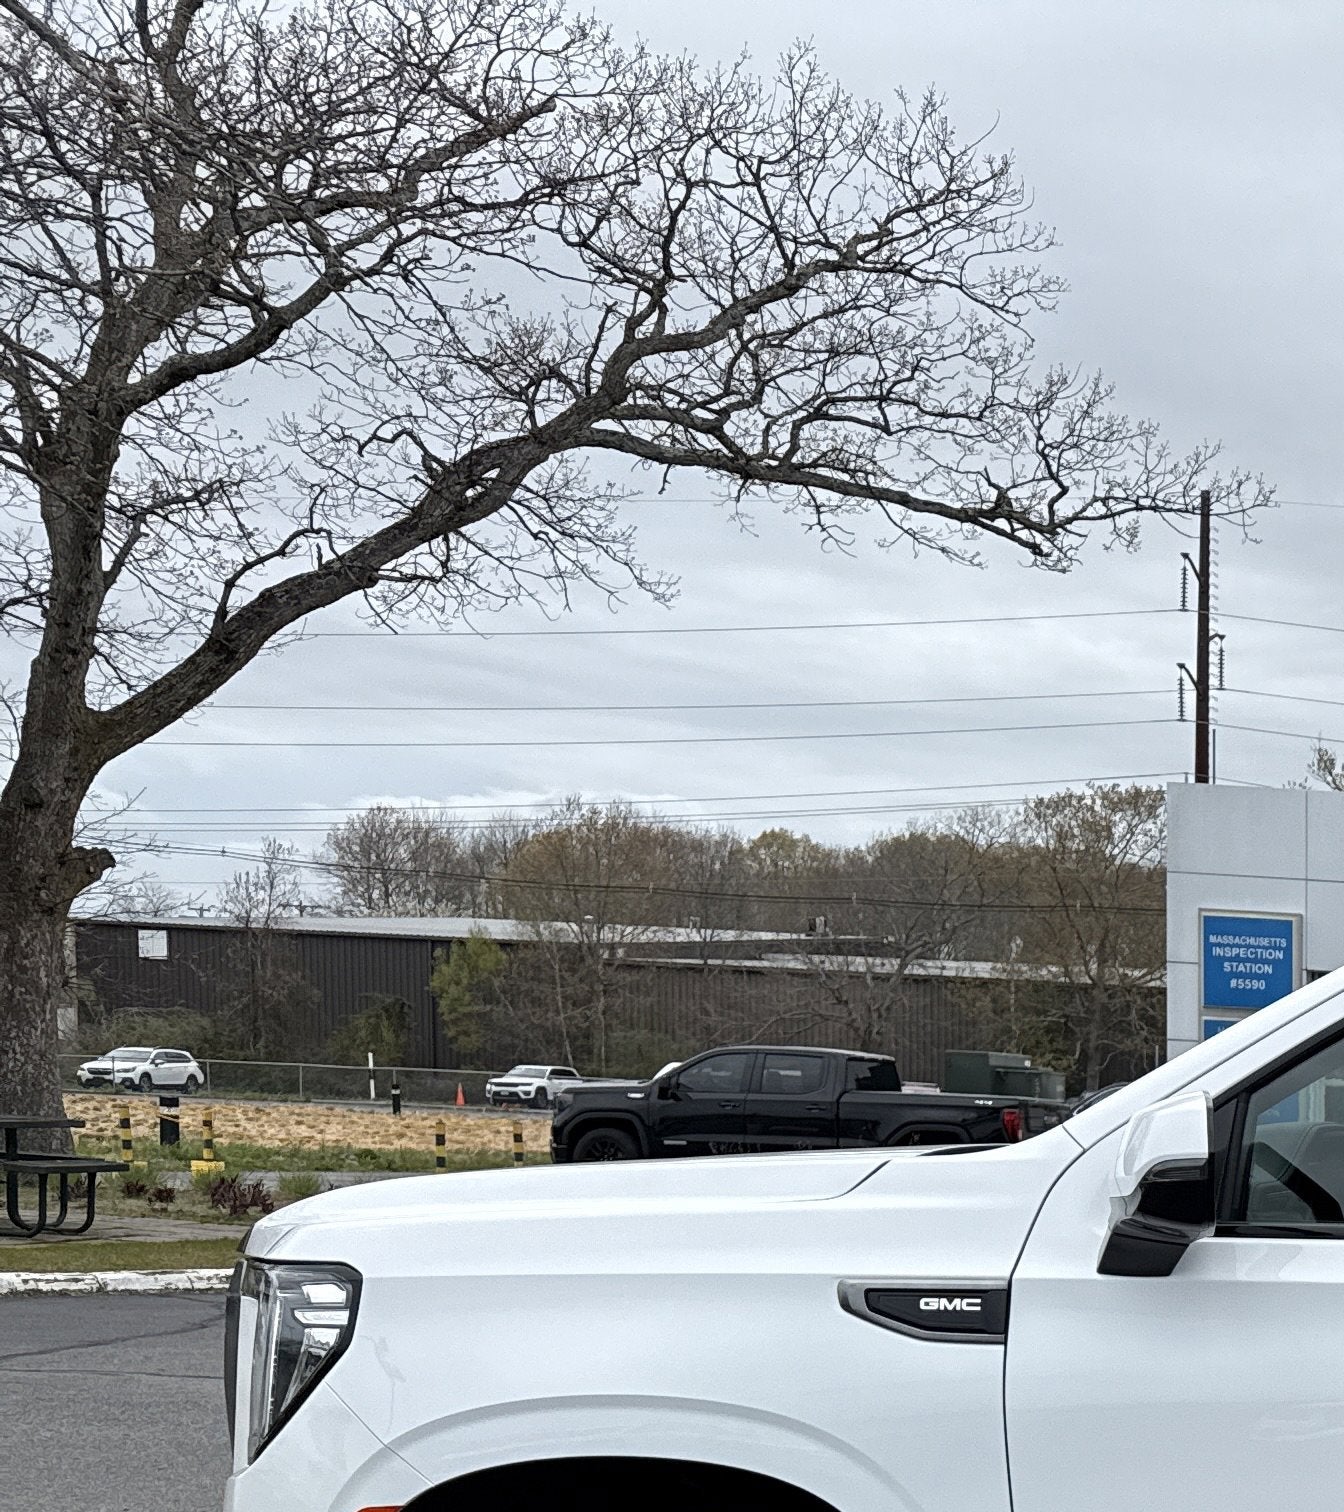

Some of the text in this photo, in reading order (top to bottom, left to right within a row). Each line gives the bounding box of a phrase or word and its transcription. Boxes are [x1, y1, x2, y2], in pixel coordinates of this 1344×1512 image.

[1208, 934, 1287, 947] MASSACHUSETTS
[1212, 946, 1283, 959] INSPECTION
[1223, 962, 1273, 974] STATION
[1230, 978, 1266, 990] #5590
[919, 1297, 982, 1312] GMC
